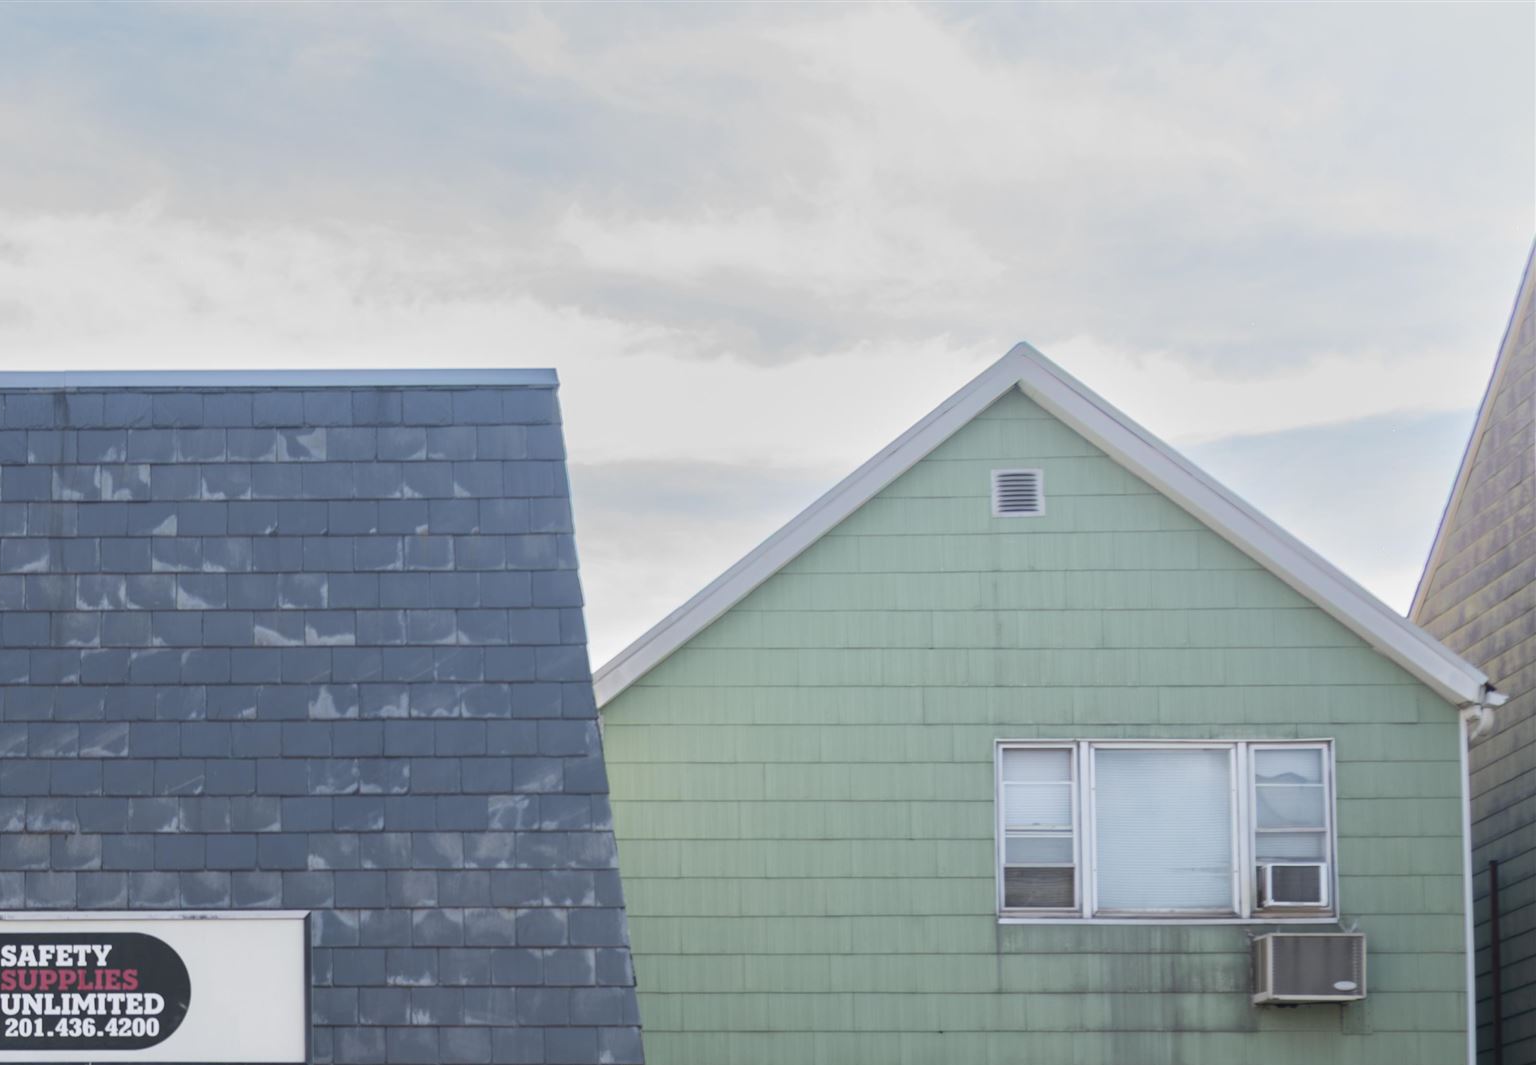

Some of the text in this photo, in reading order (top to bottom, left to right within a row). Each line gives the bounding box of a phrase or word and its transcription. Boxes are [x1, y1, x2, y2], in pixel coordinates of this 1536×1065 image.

[0, 944, 112, 968] SAFETY
[0, 968, 139, 991] SUPPLIES
[0, 992, 164, 1016] UNLIMITED
[4, 1017, 160, 1038] 201.436.4200
